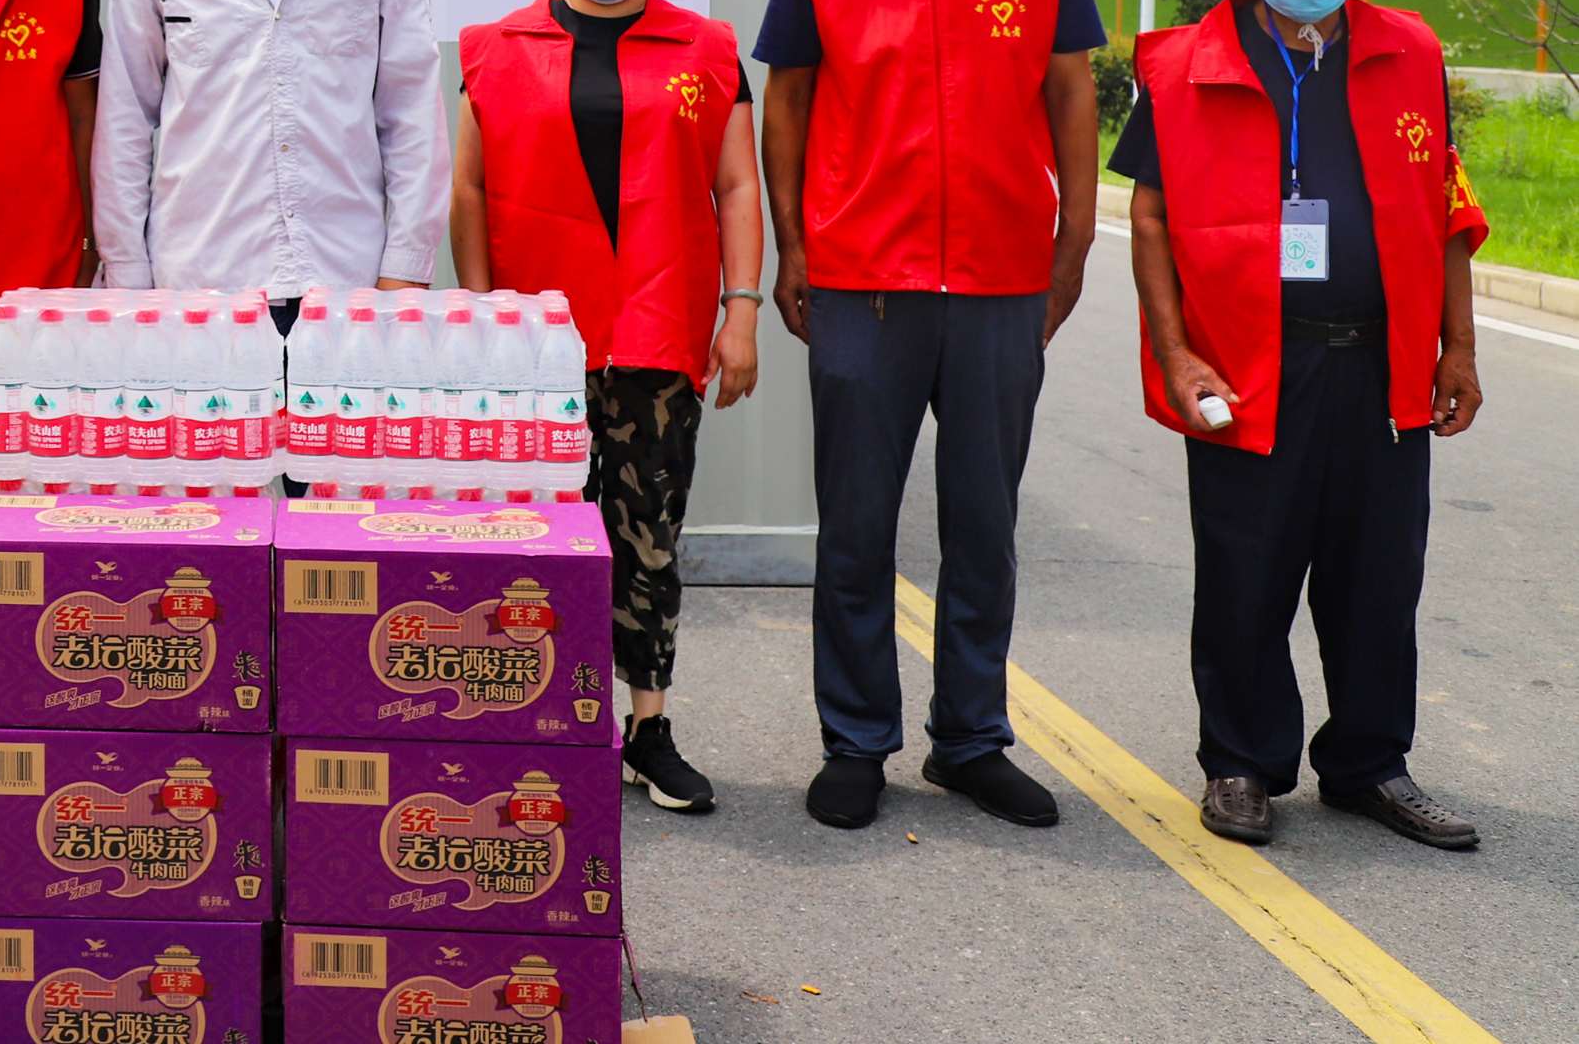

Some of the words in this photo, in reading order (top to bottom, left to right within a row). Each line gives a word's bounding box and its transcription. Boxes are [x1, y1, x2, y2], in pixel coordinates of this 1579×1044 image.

[128, 427, 166, 438] 农夫山泉
[172, 597, 203, 611] 正宗
[54, 605, 125, 632] 统一
[509, 607, 541, 621] 正宗
[389, 616, 461, 641] 统一
[53, 635, 202, 671] 老坛酸菜
[388, 645, 540, 683] 老坛酸菜
[130, 671, 186, 690] 牛肉面
[466, 683, 524, 702] 牛肉面
[173, 786, 204, 800] 正宗
[55, 796, 126, 822] 统一
[521, 800, 552, 814] 正宗
[400, 807, 472, 833] 统一
[53, 825, 203, 862] 老坛酸菜
[397, 836, 550, 875] 老坛酸菜
[130, 861, 187, 879] 牛肉面
[477, 874, 534, 893] 牛肉面
[161, 974, 193, 987] 正宗
[44, 980, 115, 1008] 统一
[517, 985, 549, 999] 正宗
[396, 989, 470, 1016] 统一
